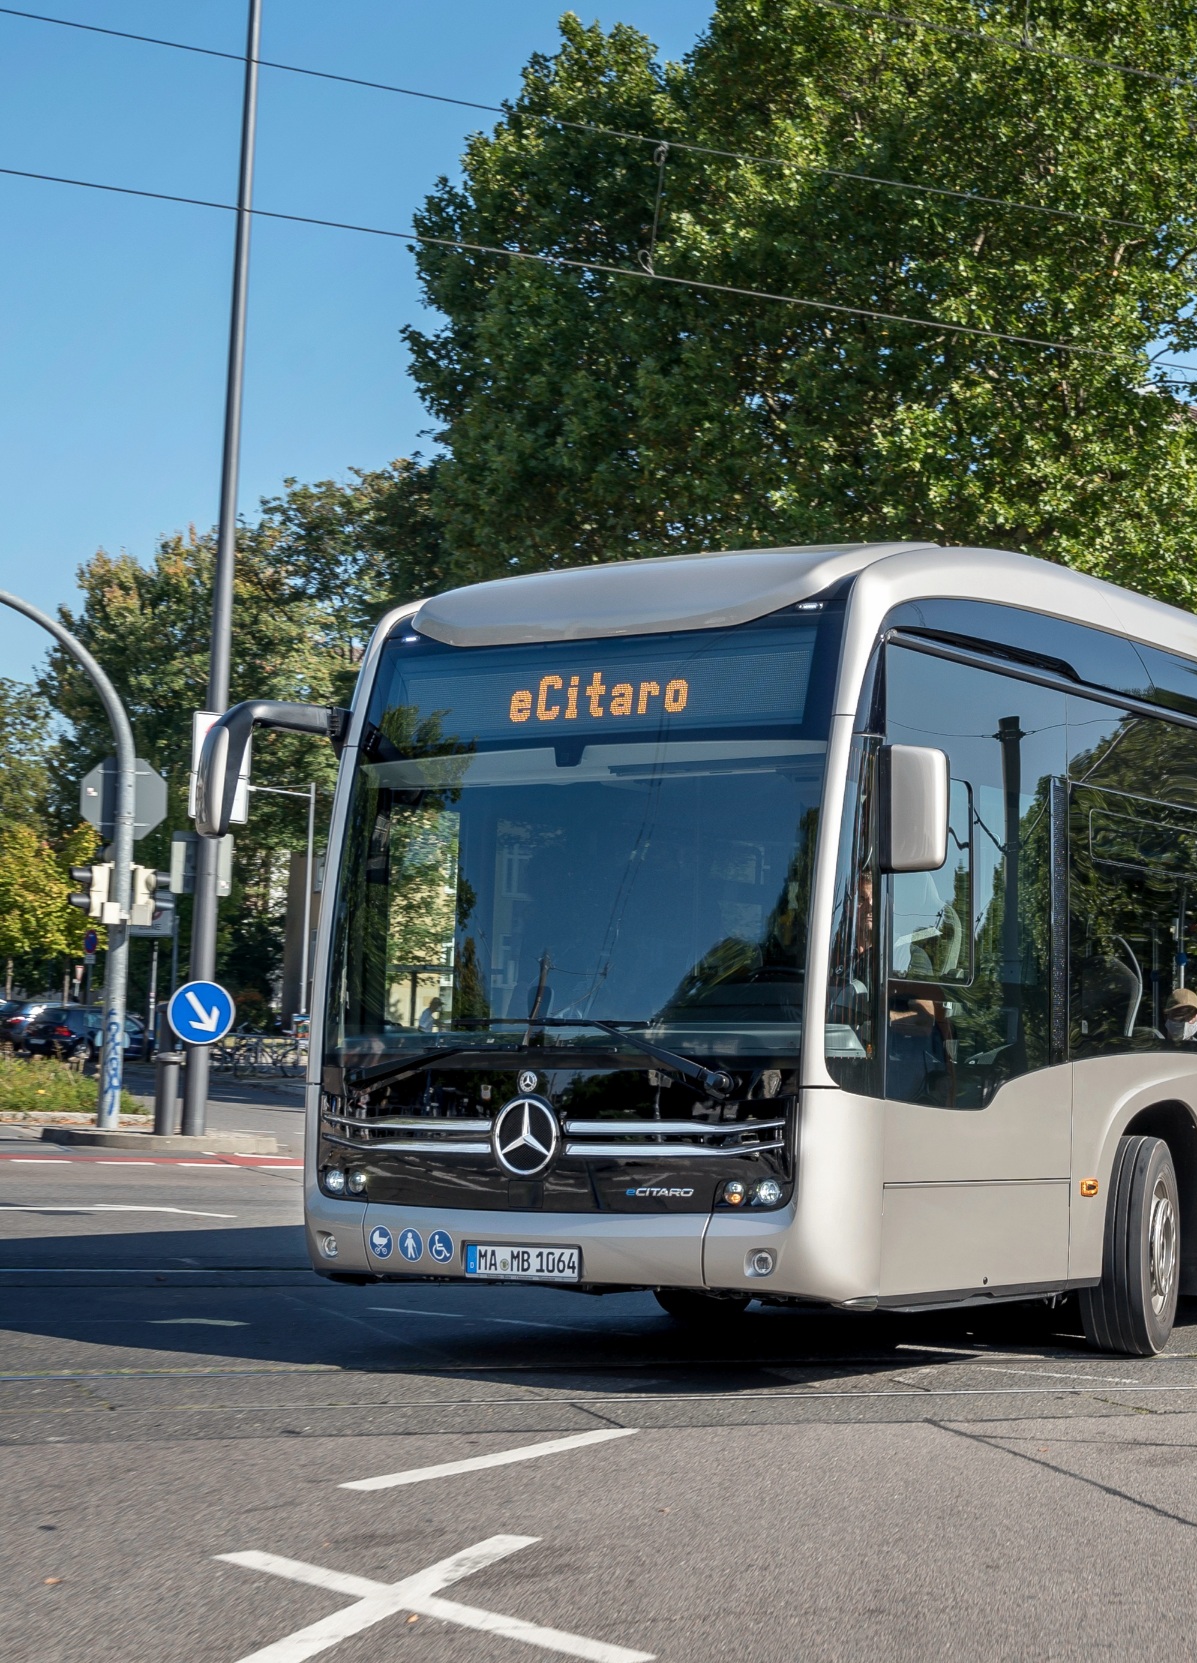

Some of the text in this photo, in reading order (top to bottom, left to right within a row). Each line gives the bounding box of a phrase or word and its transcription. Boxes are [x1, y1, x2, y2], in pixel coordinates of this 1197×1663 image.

[509, 672, 689, 722] eCitaro
[625, 1187, 695, 1197] eCITARO
[478, 1249, 498, 1271] MA
[510, 1250, 531, 1273] MB
[535, 1251, 577, 1275] 1064
